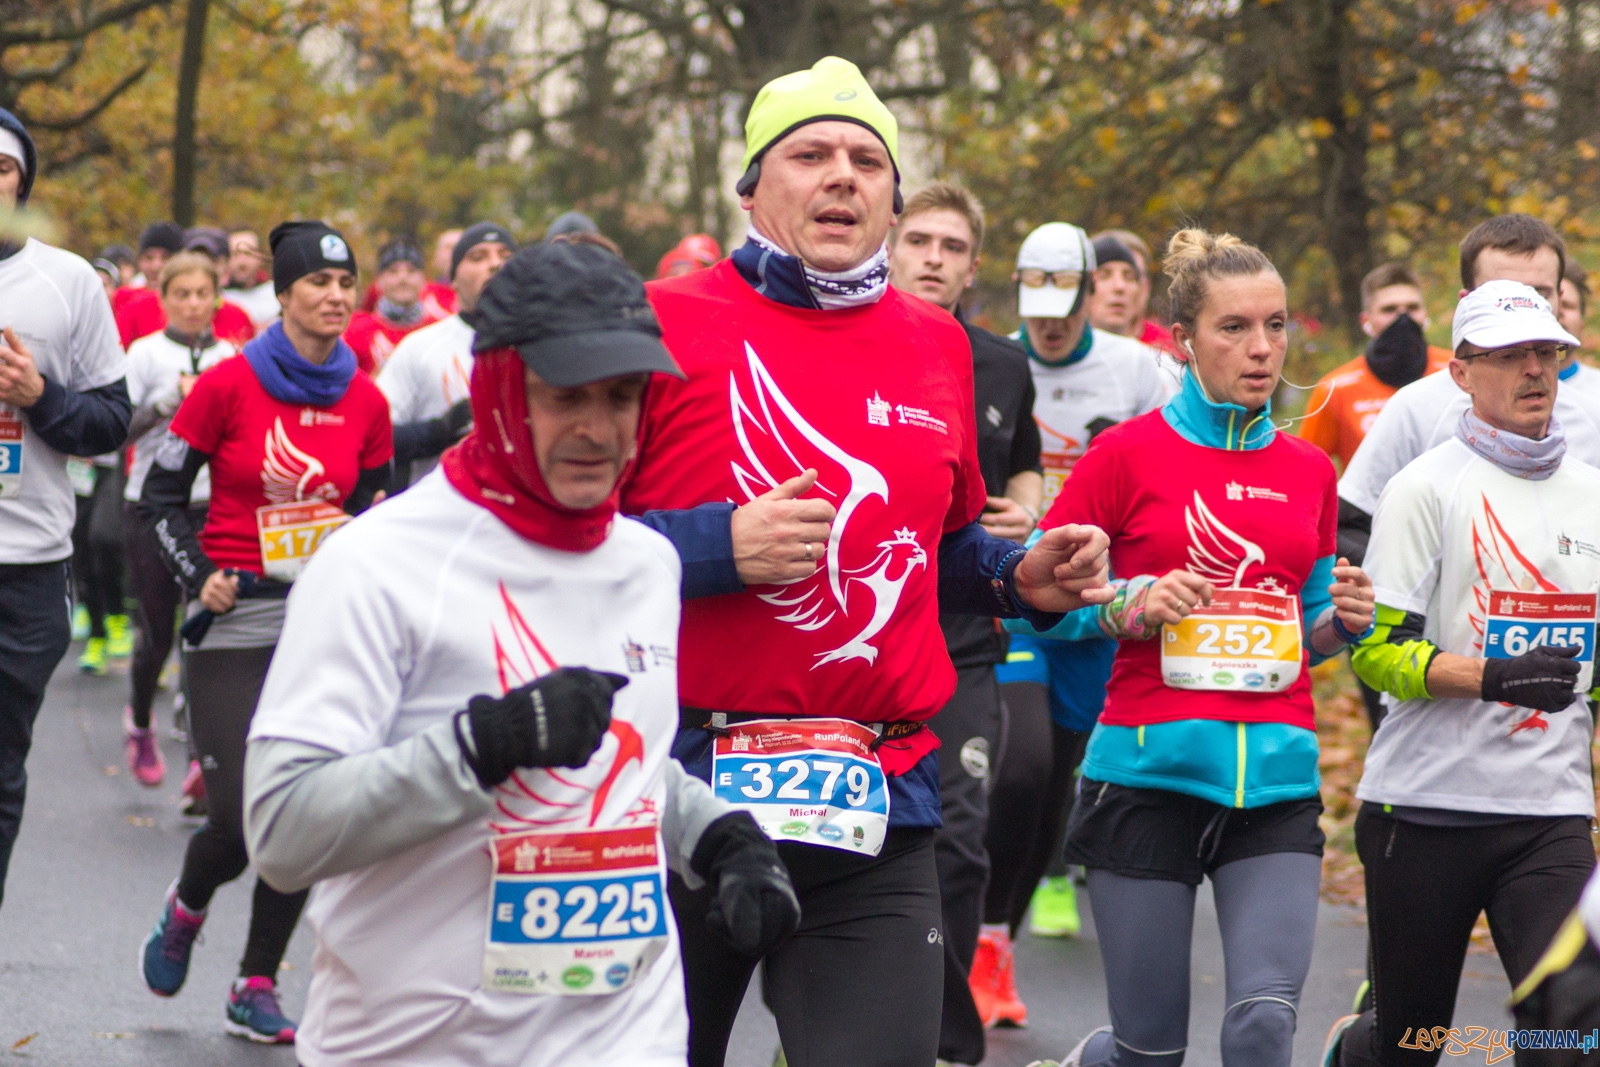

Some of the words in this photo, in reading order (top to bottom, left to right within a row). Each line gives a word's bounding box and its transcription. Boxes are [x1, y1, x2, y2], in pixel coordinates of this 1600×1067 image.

[1239, 601, 1287, 616] RunPoland.org
[1166, 632, 1178, 643] D
[1195, 622, 1275, 657] 252
[1488, 633, 1500, 645] E
[1503, 625, 1586, 658] 6455
[1211, 661, 1258, 669] Agnieszka
[755, 734, 764, 749] 1
[814, 732, 869, 755] RunPoland.org
[719, 772, 733, 786] E
[740, 759, 870, 807] 3279
[497, 902, 515, 923] E
[521, 880, 658, 939] 8225
[573, 948, 615, 959] Marcin
